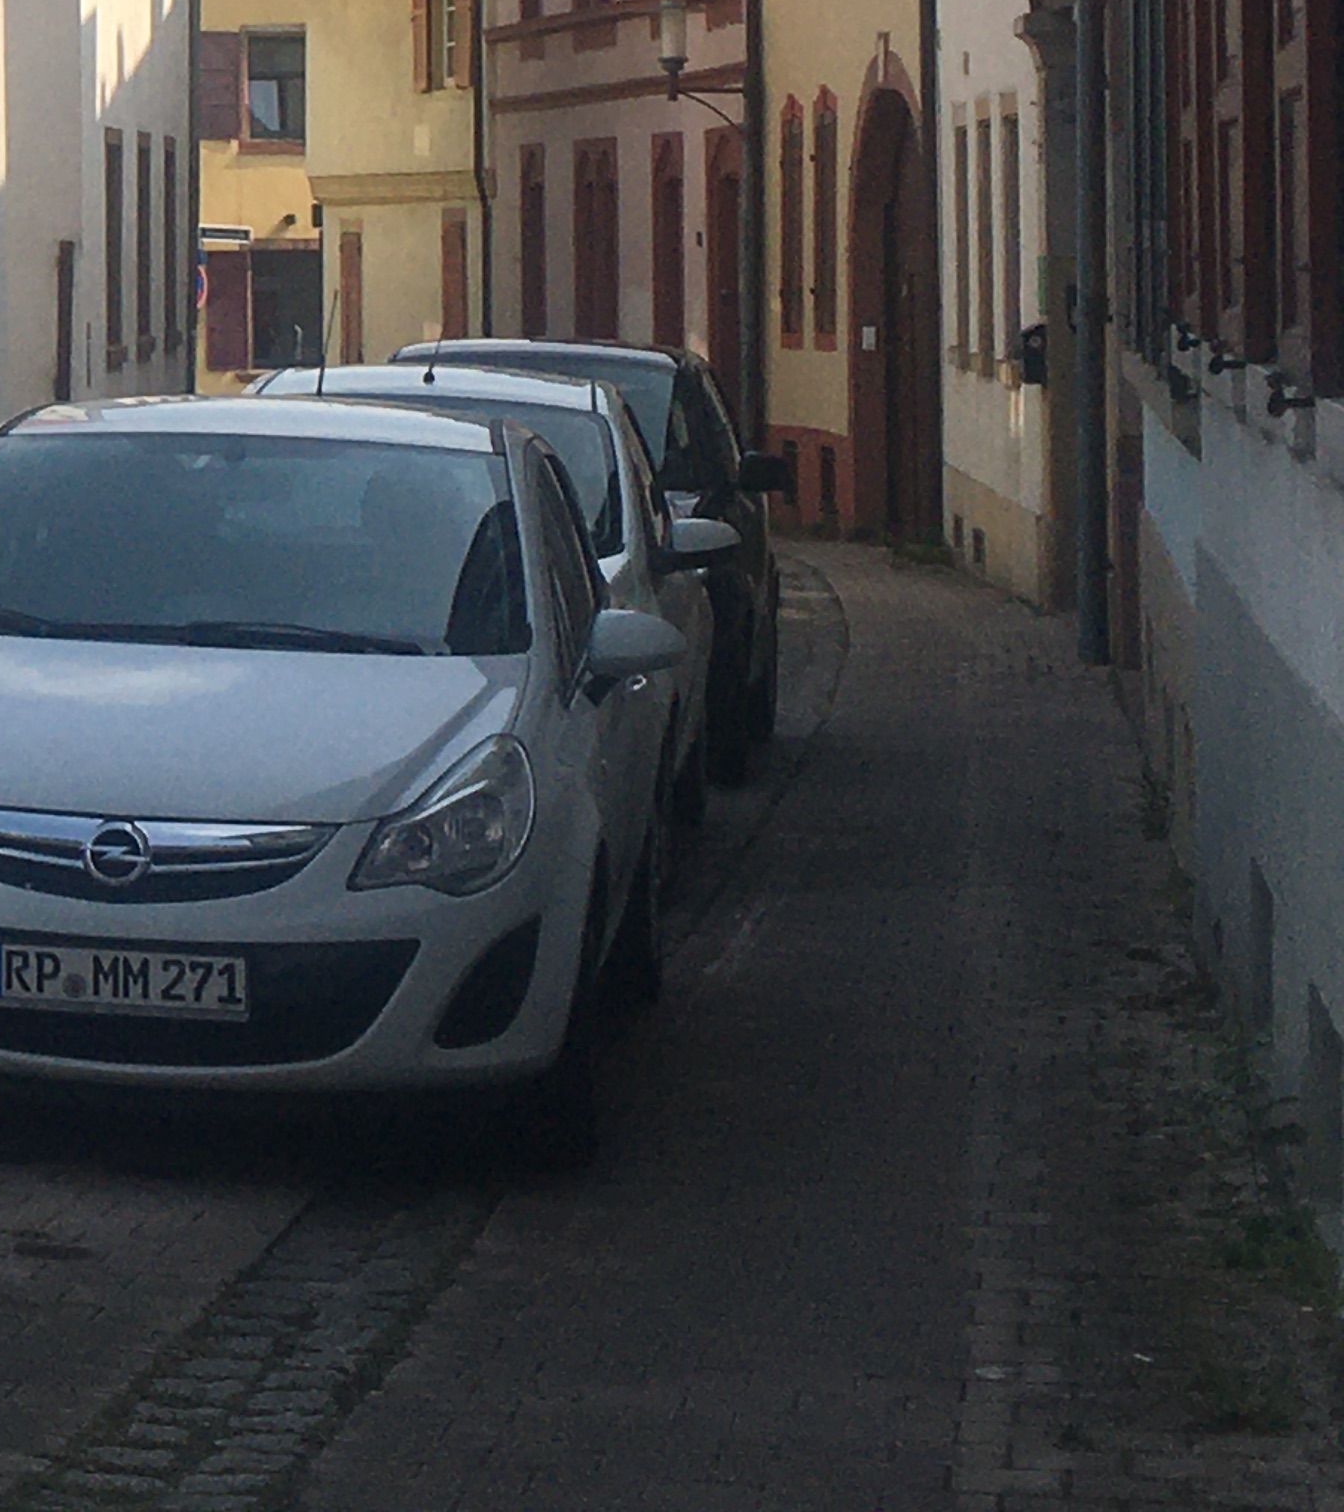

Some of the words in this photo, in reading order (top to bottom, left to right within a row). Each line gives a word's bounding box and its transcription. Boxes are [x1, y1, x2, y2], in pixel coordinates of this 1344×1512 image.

[5, 950, 61, 993] RP
[92, 954, 150, 999] MM
[160, 959, 243, 1004] 271
